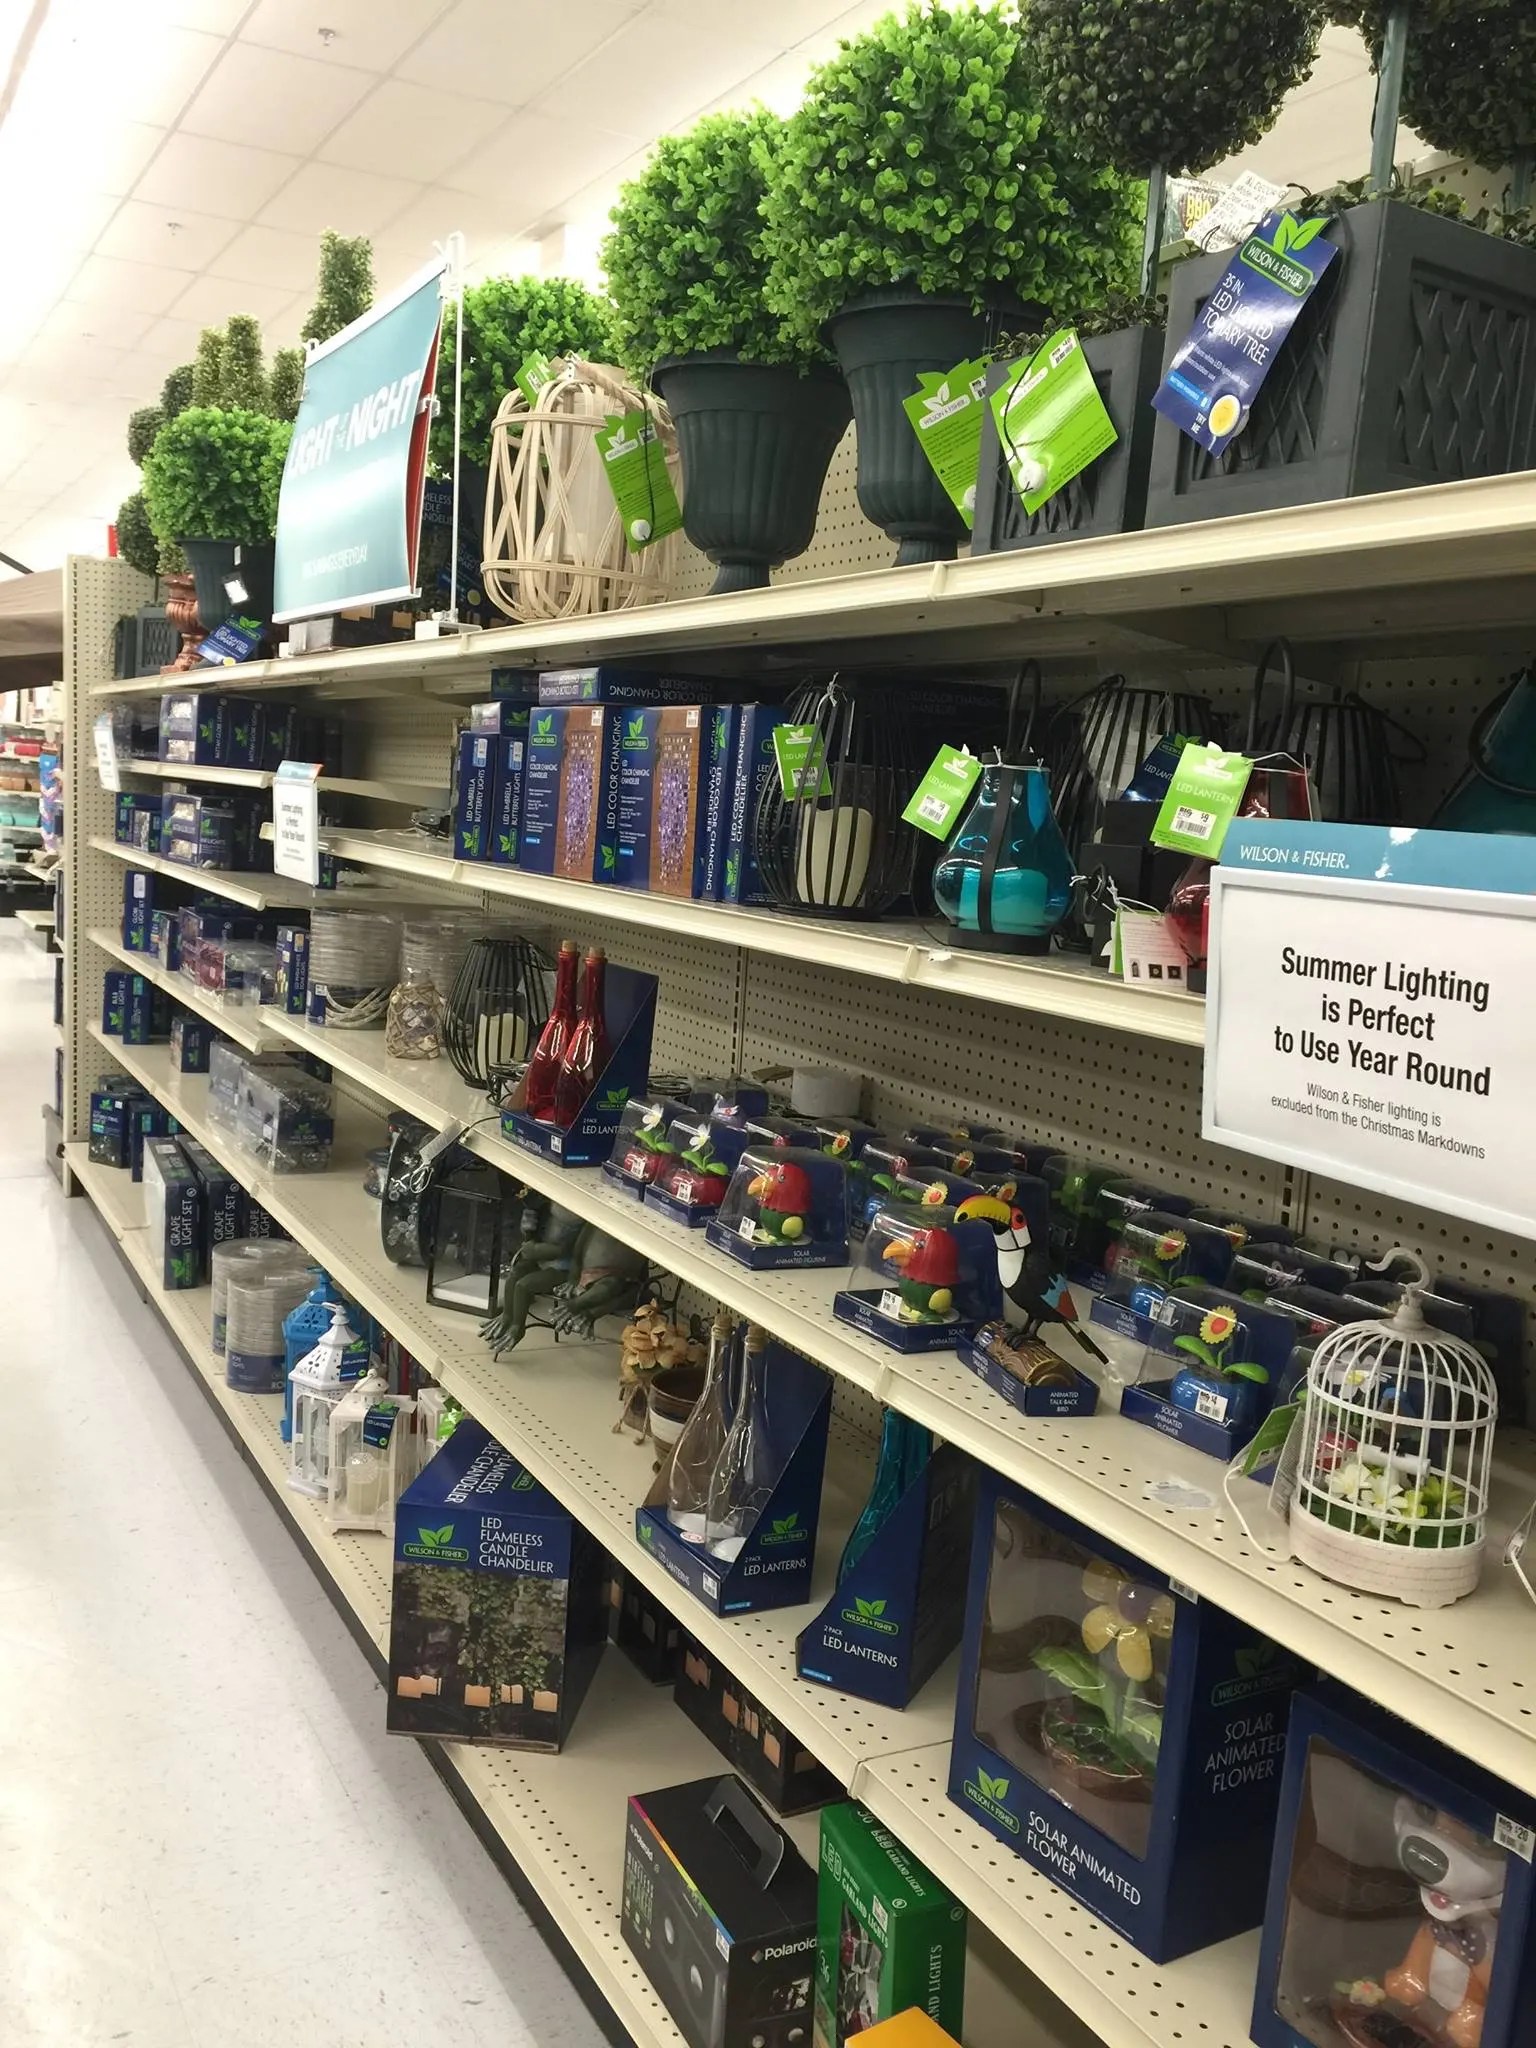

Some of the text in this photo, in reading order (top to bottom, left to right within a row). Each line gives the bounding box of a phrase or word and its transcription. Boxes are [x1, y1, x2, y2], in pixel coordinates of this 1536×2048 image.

[1247, 244, 1276, 269] WILSON
[1272, 261, 1280, 272] &
[1222, 272, 1236, 288] 35
[1212, 288, 1232, 311] LED
[1243, 335, 1269, 366] TREE
[346, 369, 421, 452] NIGHT
[1195, 412, 1207, 425] TRY
[609, 684, 661, 699] CHANGING
[736, 714, 748, 778] CHANGING
[1144, 763, 1172, 780] LED LANT
[608, 774, 619, 811] COLOR
[733, 780, 741, 821] COLOR
[1176, 782, 1235, 804] LED LANTERN
[607, 811, 616, 829] LED
[736, 774, 748, 843] CHANDELIER
[1240, 845, 1290, 863] WILSON
[1291, 851, 1300, 863] &
[1281, 946, 1491, 1012] Summer Lighting
[1321, 994, 1436, 1042] is Perfect
[1274, 1025, 1492, 1097] to Use Year Round
[1307, 1082, 1442, 1127] Wilson & Fisher lighting is
[582, 1125, 597, 1134] LED
[1271, 1094, 1486, 1160] excluded from the Christmas Markdowns
[182, 1200, 193, 1215] SET
[225, 1195, 236, 1240] LIGHT SET
[170, 1215, 181, 1246] GRAPE
[181, 1217, 192, 1246] LIGHT
[214, 1210, 224, 1240] GRAPE
[249, 1209, 260, 1240] GRAPE
[1154, 1413, 1183, 1430] ANIMATED
[1160, 1405, 1180, 1418] SOLAR
[443, 1456, 494, 1504] CHANDELIER
[480, 1529, 543, 1547] FLAMELESS
[481, 1516, 502, 1530] LED
[408, 1546, 436, 1556] WILSON
[478, 1554, 554, 1574] CHANDELIER
[479, 1542, 529, 1558] CANDLE
[743, 1557, 807, 1577] LED LANTERNS
[823, 1624, 843, 1636] 2 PACK
[846, 1612, 869, 1625] WILSON
[823, 1634, 898, 1668] LED LANTERNS
[1224, 1712, 1274, 1744] SOLAR
[1204, 1732, 1287, 1774] ANIMATED
[1212, 1758, 1274, 1794] FLOWER
[967, 1786, 991, 1811] WILSON
[994, 1807, 1015, 1827] FISHER
[871, 1828, 897, 1850] LED
[1027, 1829, 1077, 1880] FLOWER
[821, 1833, 843, 1882] LED
[1028, 1810, 1142, 1906] SOLAR ANIMATED
[886, 1849, 927, 1898] GARLAND LIGHTS
[841, 1877, 868, 1919] GARLAND
[867, 1913, 889, 1949] LIGHTS
[764, 1936, 819, 1961] Polaroid
[928, 1943, 943, 1994] LIGHTS
